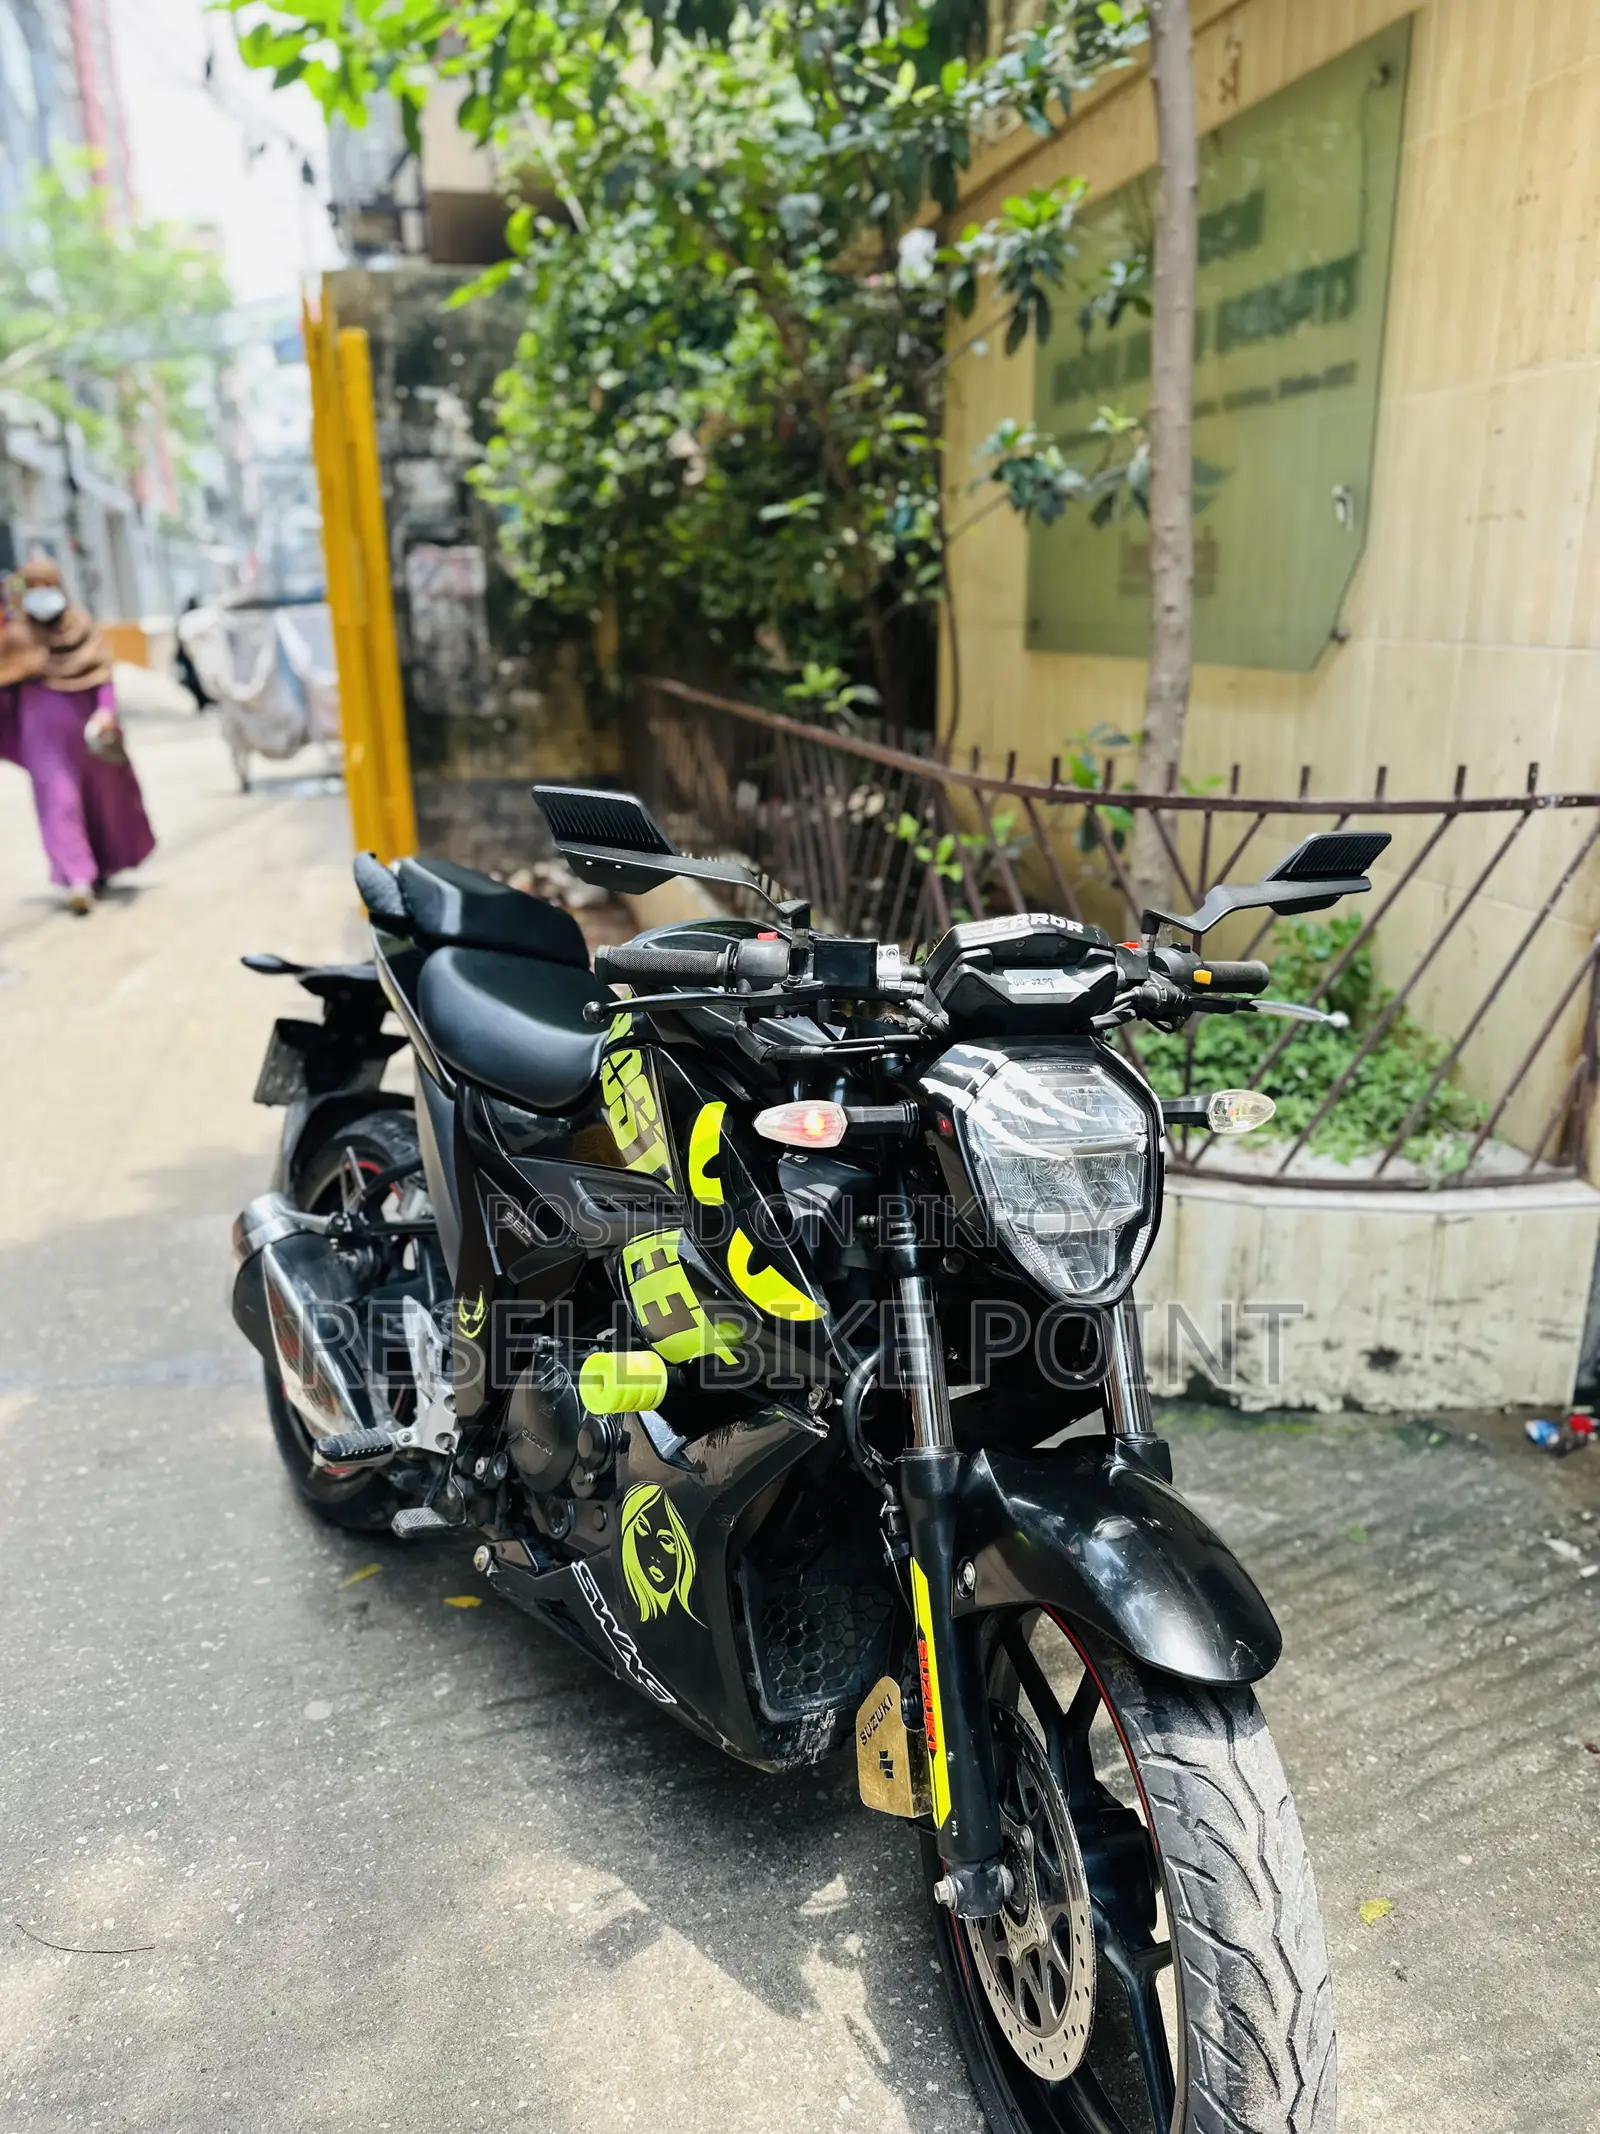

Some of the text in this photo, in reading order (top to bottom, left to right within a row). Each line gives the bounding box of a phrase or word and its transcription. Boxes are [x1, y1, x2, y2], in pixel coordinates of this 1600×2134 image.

[504, 1211, 532, 1238] SEP
[859, 1694, 894, 1746] SUZUKI
[918, 1638, 938, 1751] SUZUKI
